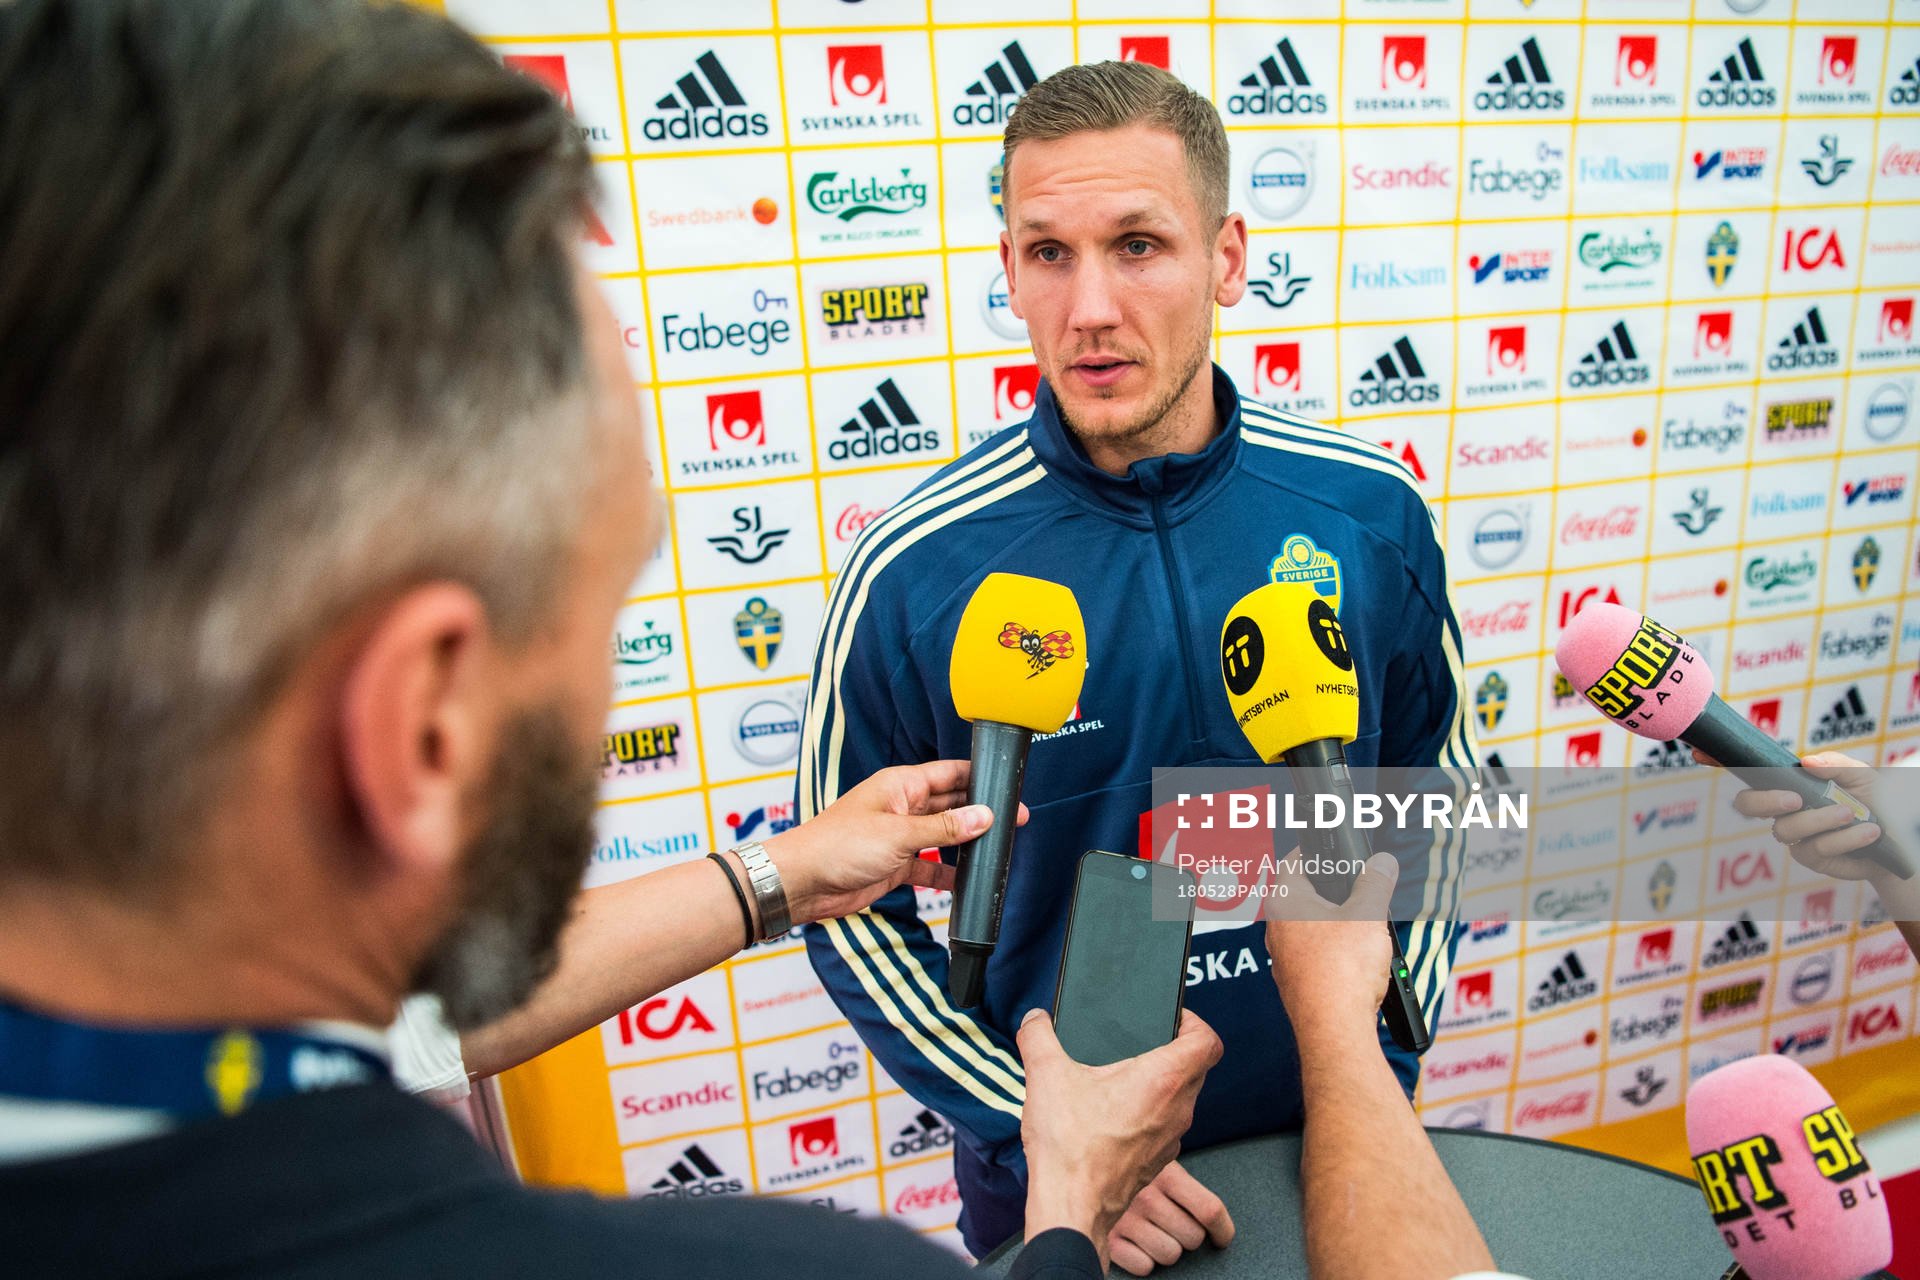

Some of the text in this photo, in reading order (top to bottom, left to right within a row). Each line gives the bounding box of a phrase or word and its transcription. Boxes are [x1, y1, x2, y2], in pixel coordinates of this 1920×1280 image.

[1228, 87, 1327, 115] adidas
[1474, 83, 1564, 111] adidas
[1698, 83, 1776, 107] adidas
[643, 107, 768, 140] adidas
[802, 113, 922, 131] SVENSKA SPEL
[807, 169, 927, 216] Carlsberg
[1352, 164, 1451, 190] Scandic
[1469, 158, 1562, 200] Fabege
[648, 208, 747, 227] Swedbank
[1268, 252, 1290, 276] SJ
[1782, 227, 1846, 272] ICA
[1352, 261, 1447, 288] Folksam
[821, 284, 929, 329] SPORT
[662, 313, 790, 355] Fabege
[830, 321, 928, 340] BLADET
[1768, 348, 1839, 371] adidas
[1569, 364, 1650, 388] adidas
[1350, 381, 1440, 407] adidas
[829, 426, 939, 461] adidas
[1458, 434, 1548, 467] Scandic
[1662, 418, 1744, 452] Fabege
[682, 451, 800, 475] SVENSKA SPEL
[734, 506, 762, 533] SJ
[1283, 568, 1329, 582] SVERIGE
[1584, 616, 1684, 720] SPORT
[1626, 641, 1694, 728] BLADE
[1078, 719, 1104, 733] SPEL
[594, 832, 700, 863] olksam
[1716, 851, 1774, 893] ICA
[617, 995, 716, 1046] ICA
[1849, 1002, 1901, 1043] ICA
[753, 1059, 859, 1102] Fabege
[622, 1081, 735, 1119] Scandic
